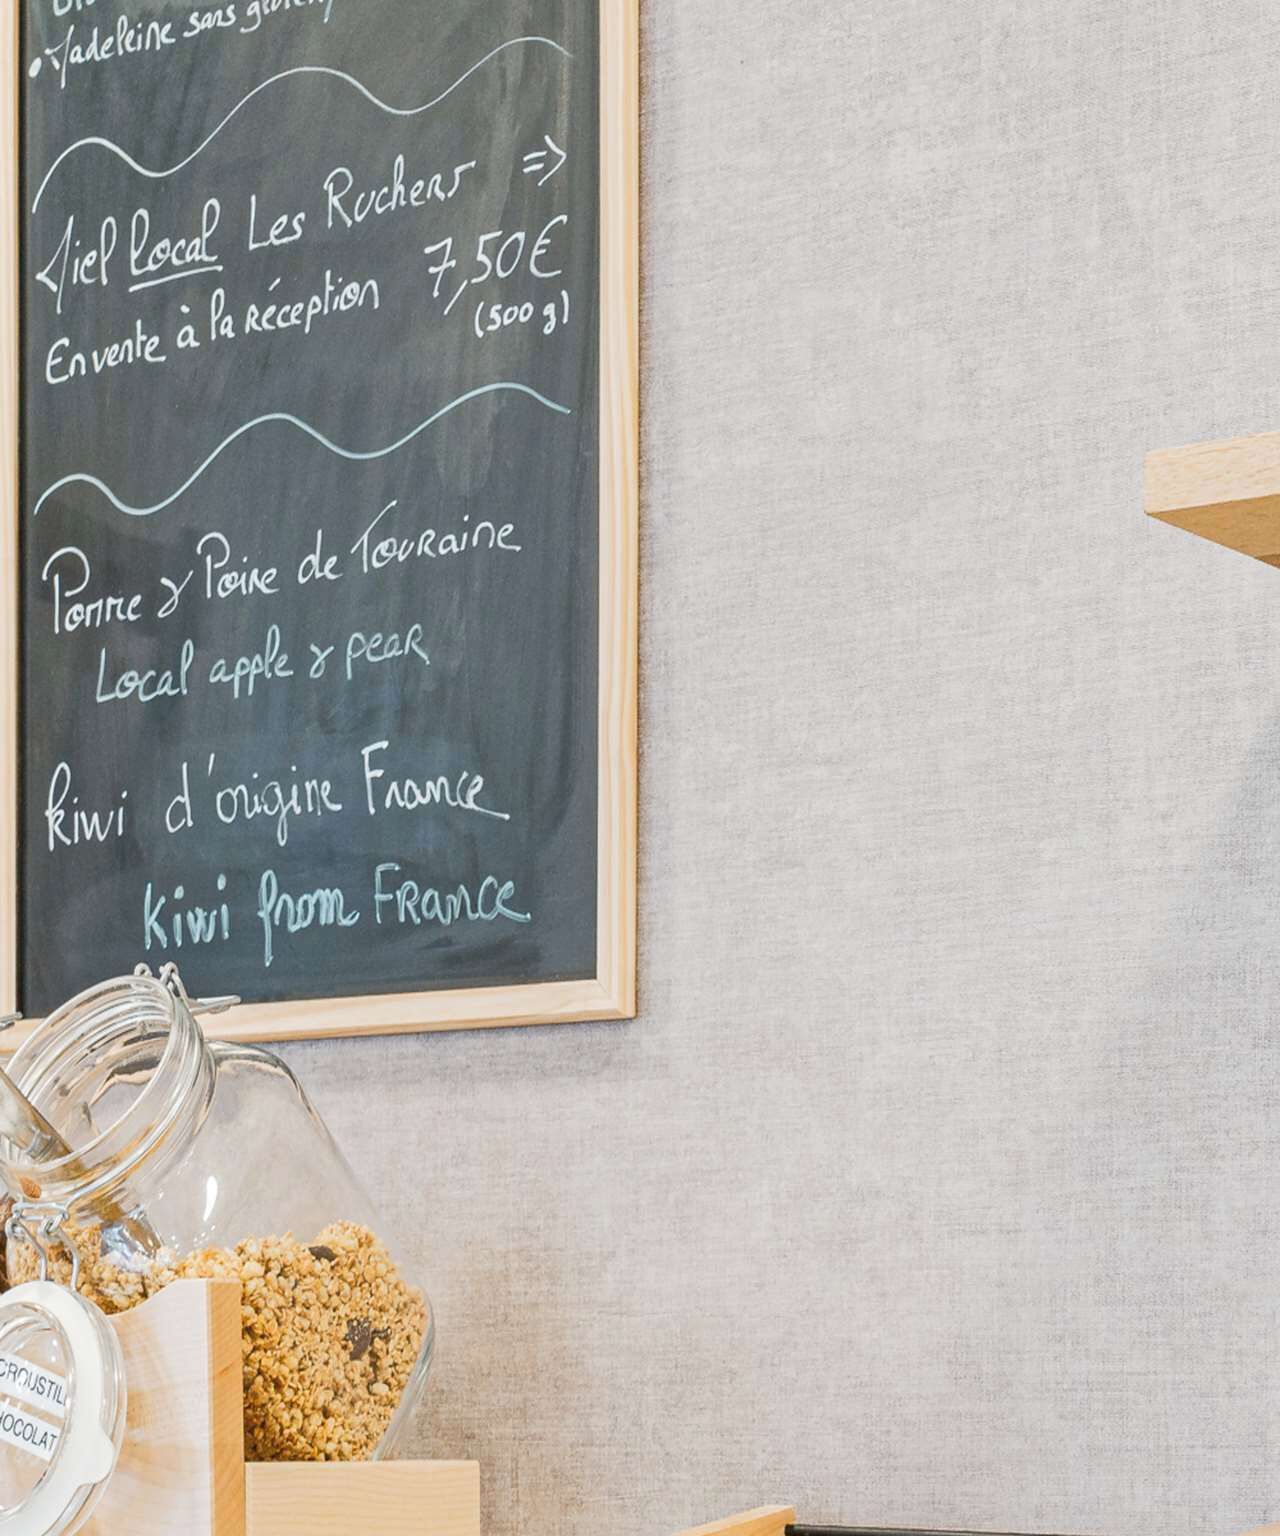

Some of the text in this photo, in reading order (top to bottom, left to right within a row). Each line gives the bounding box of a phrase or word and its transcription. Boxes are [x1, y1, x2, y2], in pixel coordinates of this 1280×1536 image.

[183, 4, 237, 37] sans
[249, 194, 306, 250] Les
[424, 213, 568, 316] 7,50€
[176, 304, 200, 348] à
[210, 288, 235, 341] la
[196, 531, 280, 599] Poire
[297, 528, 344, 584] de
[95, 638, 194, 703] Local
[209, 624, 294, 699] apple
[165, 752, 342, 847] d'origine
[361, 740, 511, 822] France
[257, 869, 361, 968] from
[374, 862, 532, 925] France
